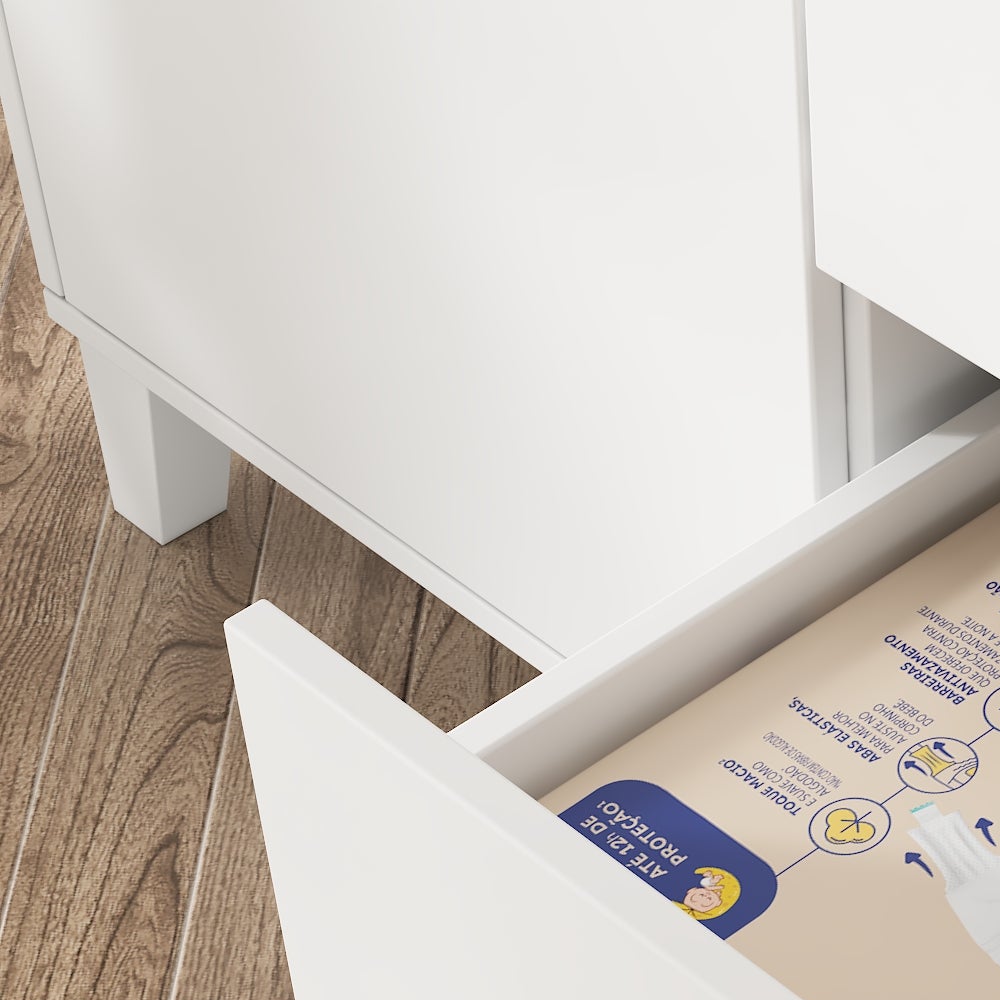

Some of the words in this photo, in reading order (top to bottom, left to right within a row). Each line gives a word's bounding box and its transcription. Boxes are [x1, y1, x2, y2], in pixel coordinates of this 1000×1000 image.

[917, 605, 960, 633] DURANTE
[960, 615, 989, 635] NOITE.
[922, 624, 959, 649] CONTRA
[985, 632, 998, 640] A
[883, 632, 978, 694] ANTIVAZAMENTO
[924, 643, 971, 674] OFERECEM
[899, 661, 964, 704] BARREIRAS
[966, 671, 990, 687] QUE
[788, 696, 849, 742] ELÁSTICAS,
[832, 711, 871, 736] MELHOR
[857, 711, 876, 723] NO
[872, 702, 920, 735] CORPINHO
[914, 713, 933, 726] DO
[871, 720, 906, 743] AJUSTE
[847, 739, 881, 763] ABAS
[867, 735, 894, 753] PARA
[751, 761, 783, 782] COMO
[760, 786, 801, 814] TOQUE
[778, 779, 810, 801] SUAVE
[580, 815, 607, 835] DE
[605, 832, 634, 856] 12h
[626, 852, 667, 879] ATÉ
